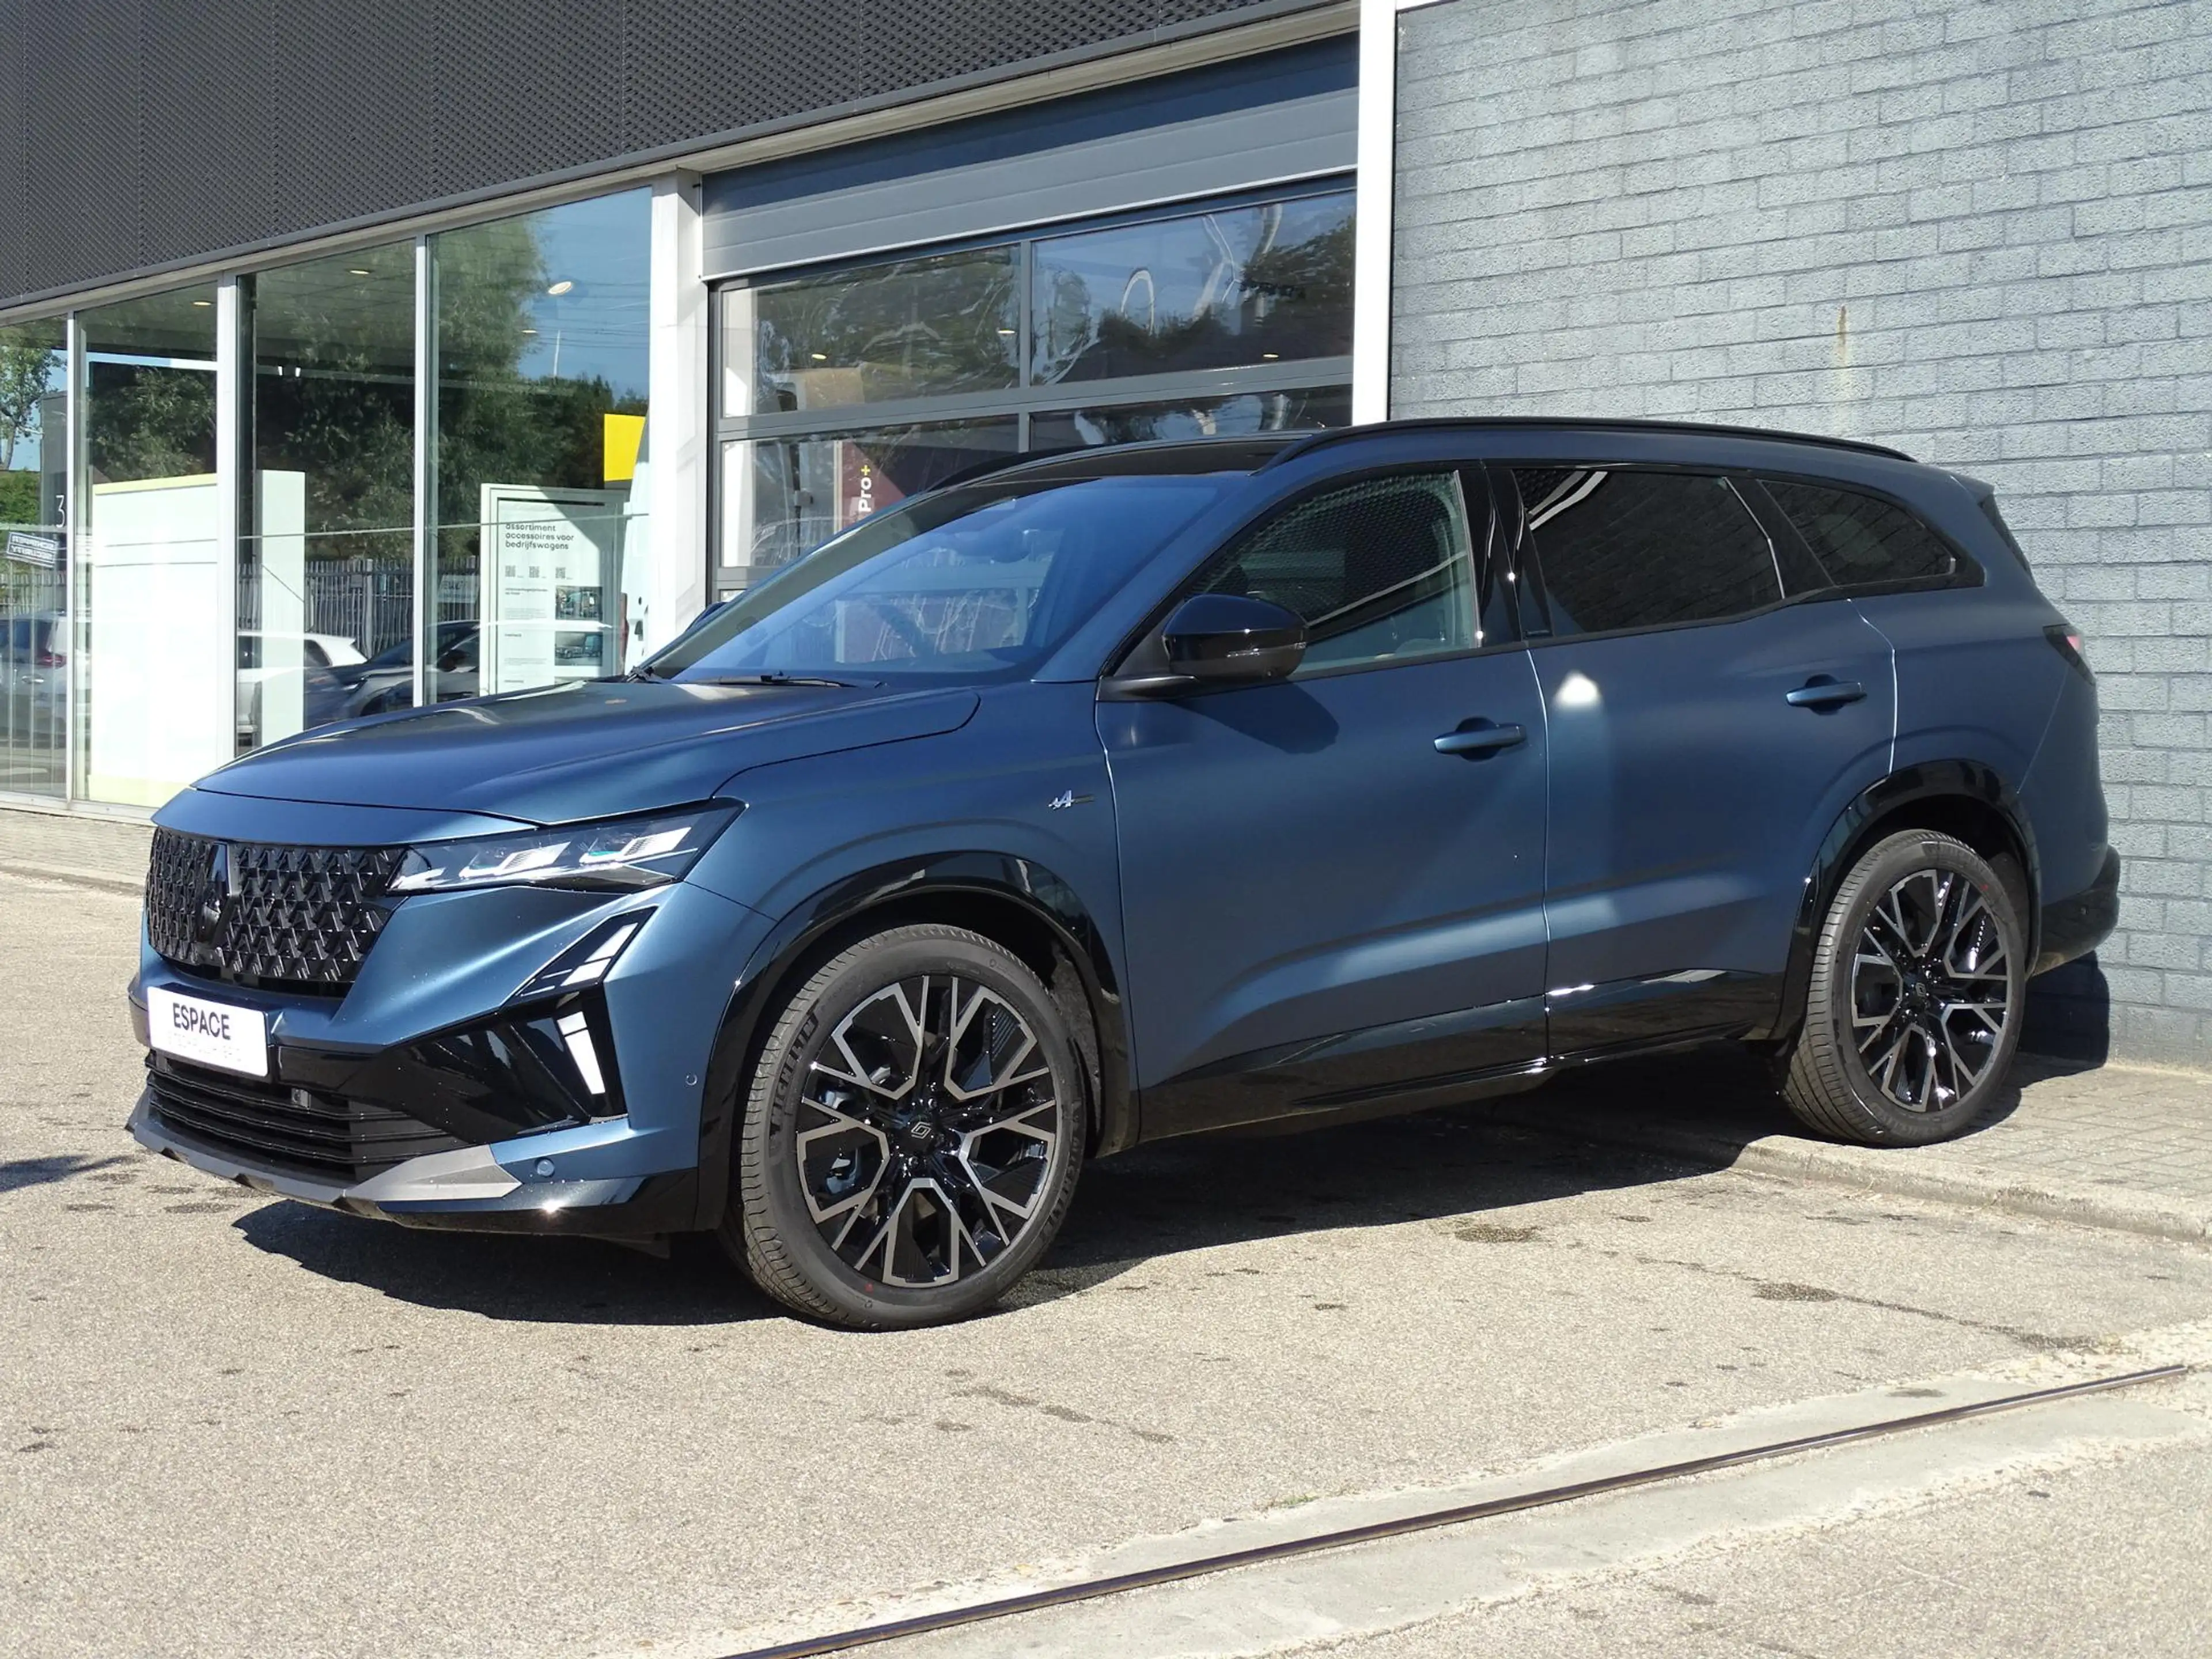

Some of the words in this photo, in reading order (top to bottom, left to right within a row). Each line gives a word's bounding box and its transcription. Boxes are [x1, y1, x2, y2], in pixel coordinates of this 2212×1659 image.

[858, 464, 872, 512] Pro+
[505, 522, 555, 531] assortiment
[505, 532, 555, 540] accessoires
[505, 540, 569, 551] bedrijfswagens
[173, 1002, 231, 1040] ESPACE
